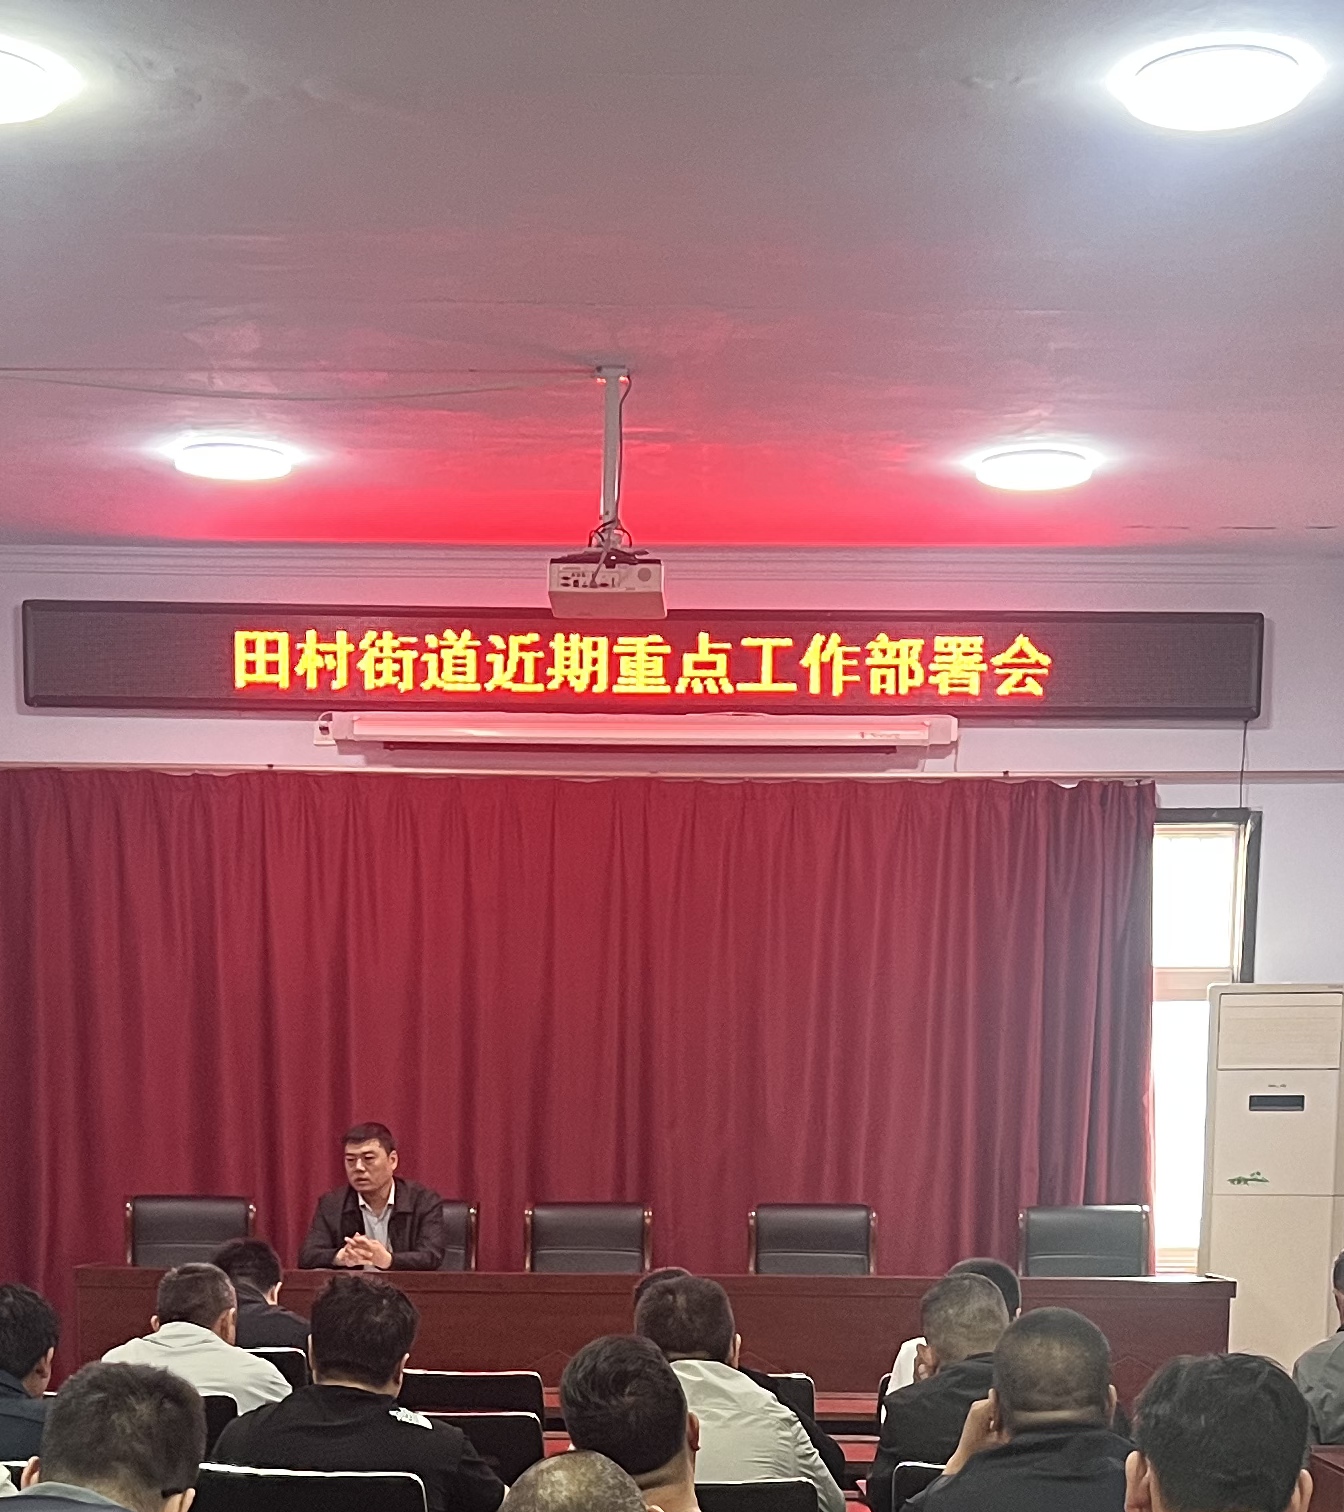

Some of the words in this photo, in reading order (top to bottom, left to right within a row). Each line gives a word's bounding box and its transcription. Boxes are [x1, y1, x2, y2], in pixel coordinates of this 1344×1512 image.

[233, 629, 1052, 697] 田村街道近期重点工作部署会
